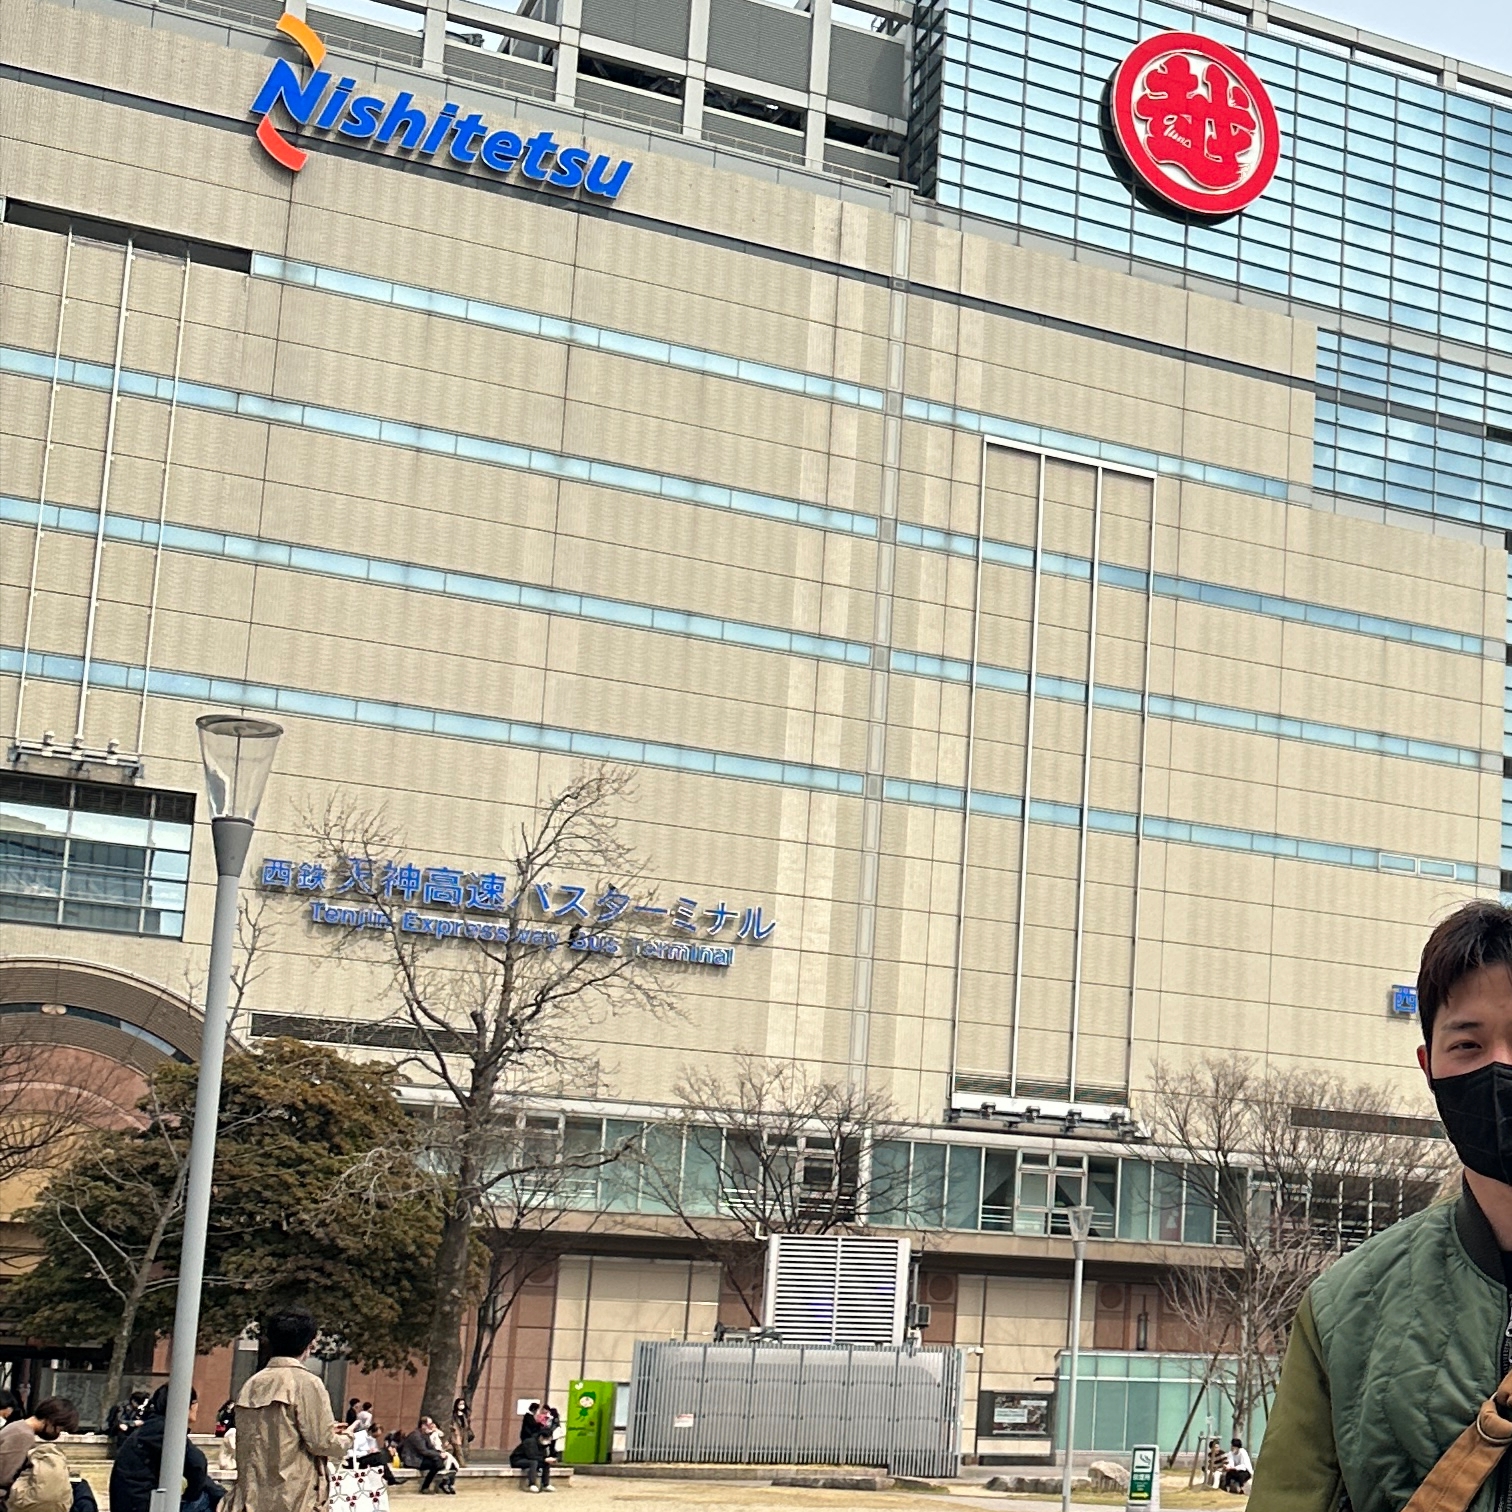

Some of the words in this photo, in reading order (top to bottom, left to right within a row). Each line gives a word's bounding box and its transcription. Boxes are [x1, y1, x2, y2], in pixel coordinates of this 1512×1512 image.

[250, 58, 634, 200] Nishitetsu
[309, 901, 394, 931] Tenjin
[570, 930, 620, 955] Bus
[630, 938, 735, 966] Terminal
